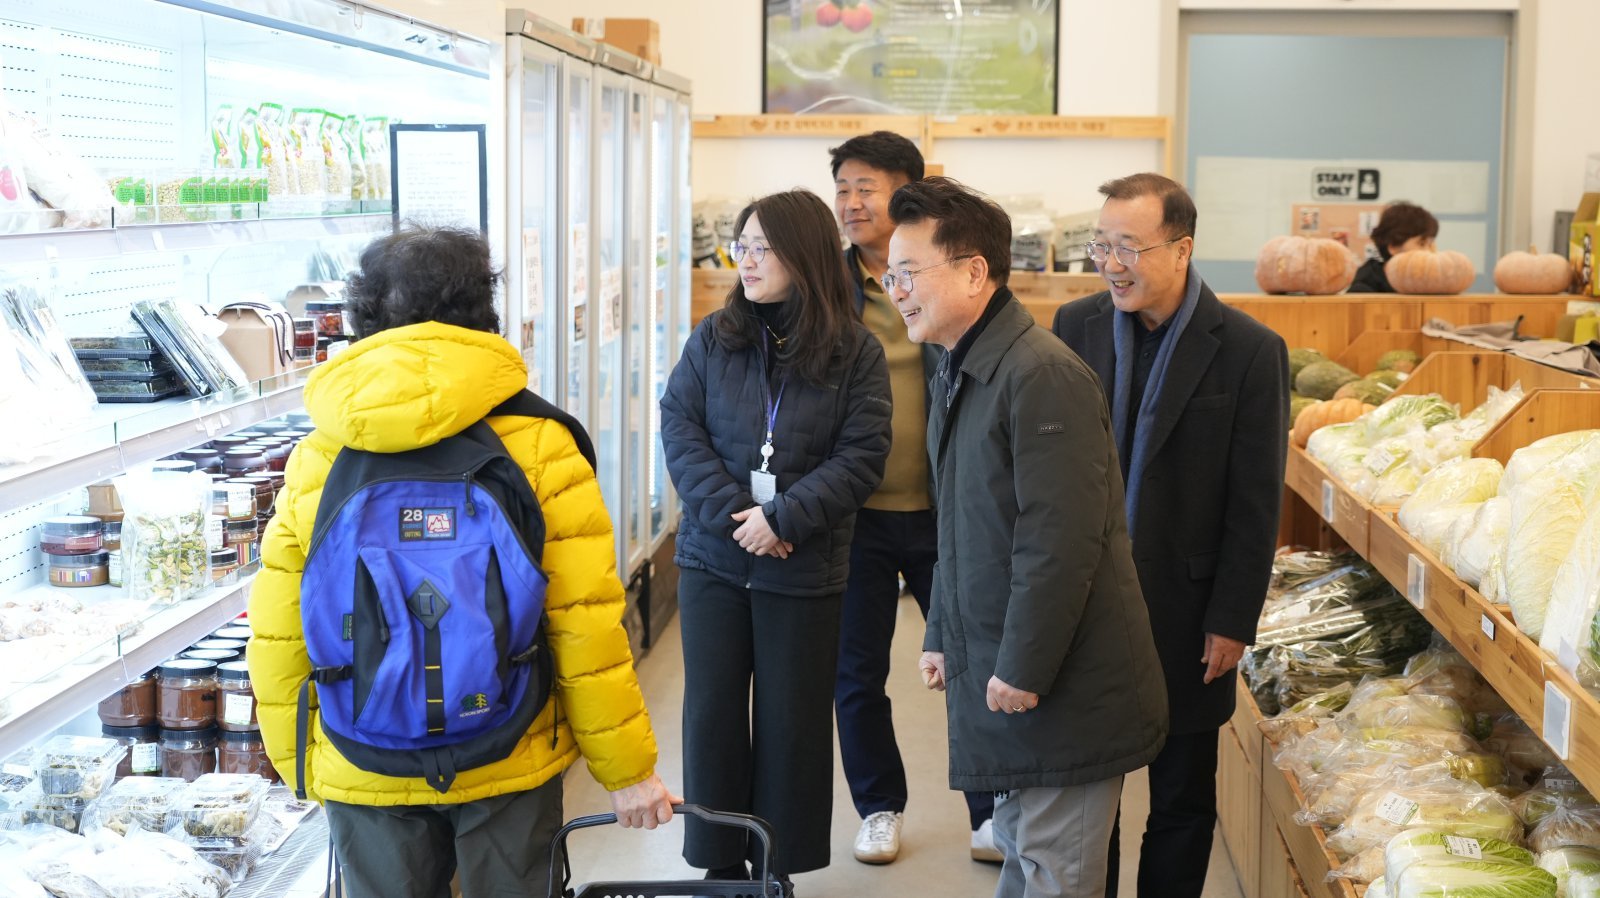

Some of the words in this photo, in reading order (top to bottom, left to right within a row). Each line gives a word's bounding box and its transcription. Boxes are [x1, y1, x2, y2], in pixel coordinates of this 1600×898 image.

[1316, 173, 1355, 183] STAFF
[1318, 186, 1352, 196] ONLY
[403, 509, 423, 522] 28
